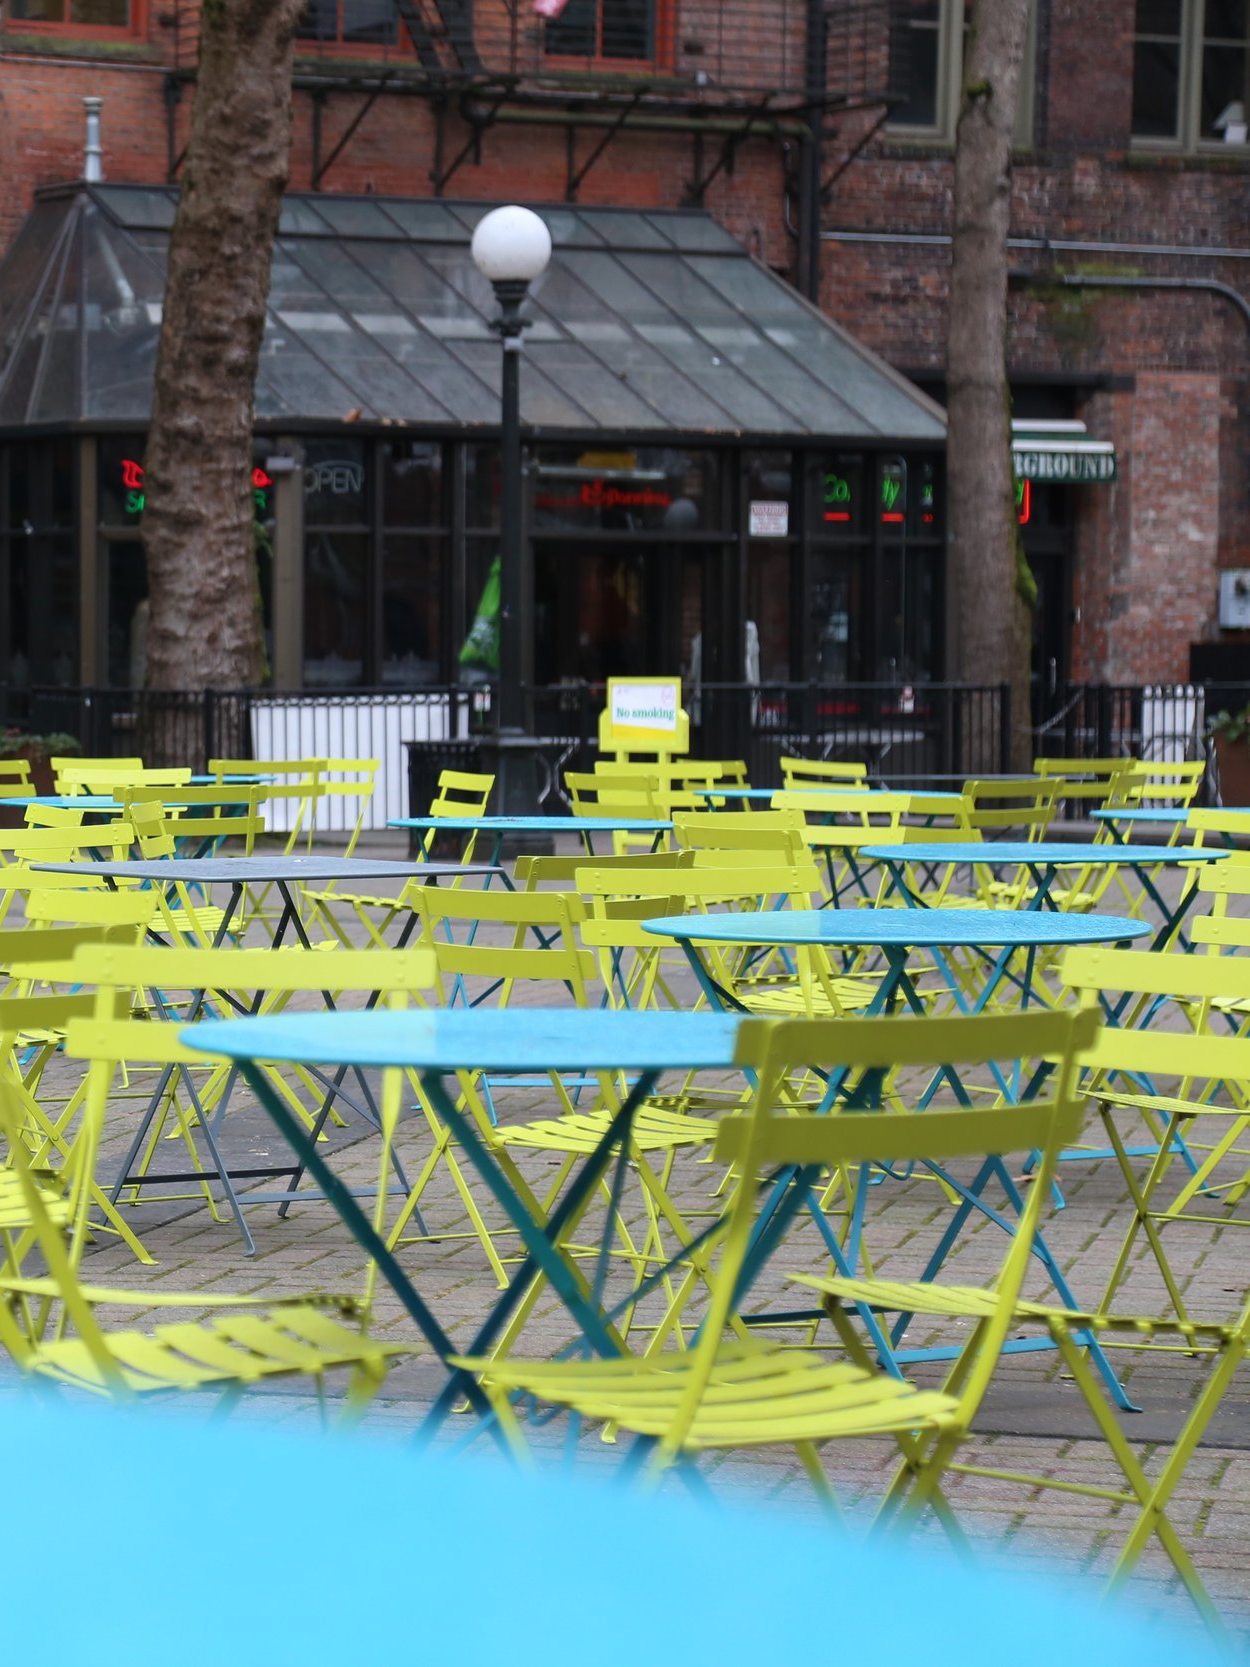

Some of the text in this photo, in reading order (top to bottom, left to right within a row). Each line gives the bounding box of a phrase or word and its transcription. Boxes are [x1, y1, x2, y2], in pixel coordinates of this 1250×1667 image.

[1013, 452, 1115, 479] RGROUND
[303, 467, 362, 493] OPEN
[616, 707, 675, 721] No smoking
